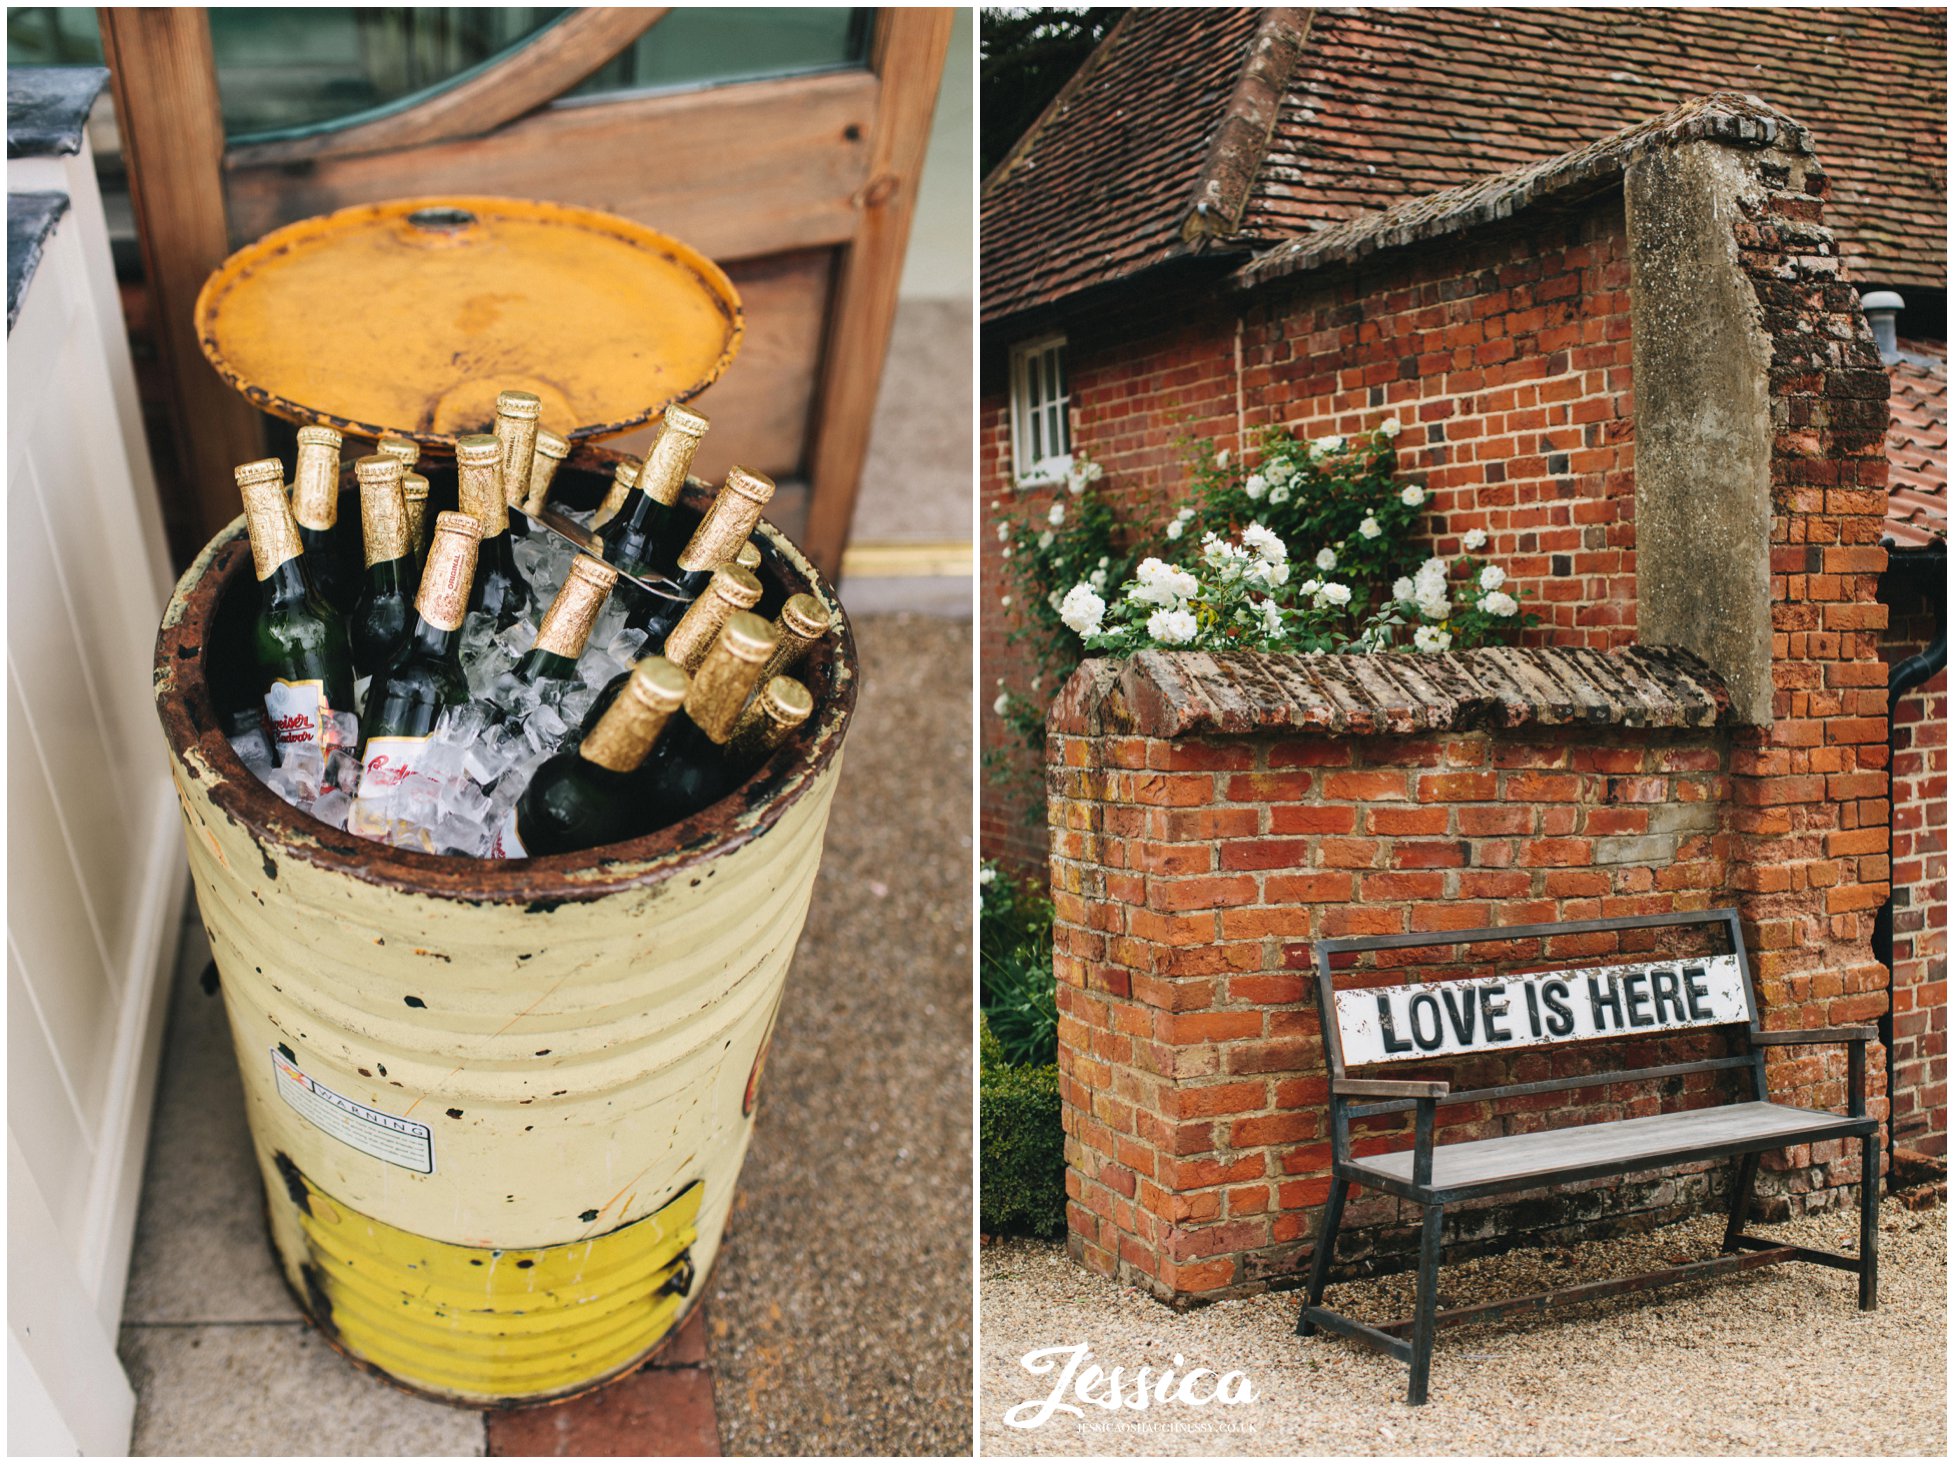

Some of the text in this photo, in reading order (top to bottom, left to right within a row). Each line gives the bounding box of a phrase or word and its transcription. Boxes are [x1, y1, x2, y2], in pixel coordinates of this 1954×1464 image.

[505, 435, 516, 469] ORIGINAL
[447, 554, 461, 590] ORIGINAL
[1376, 966, 1714, 1054] LOVE IS HERE
[318, 1087, 424, 1136] WARNING
